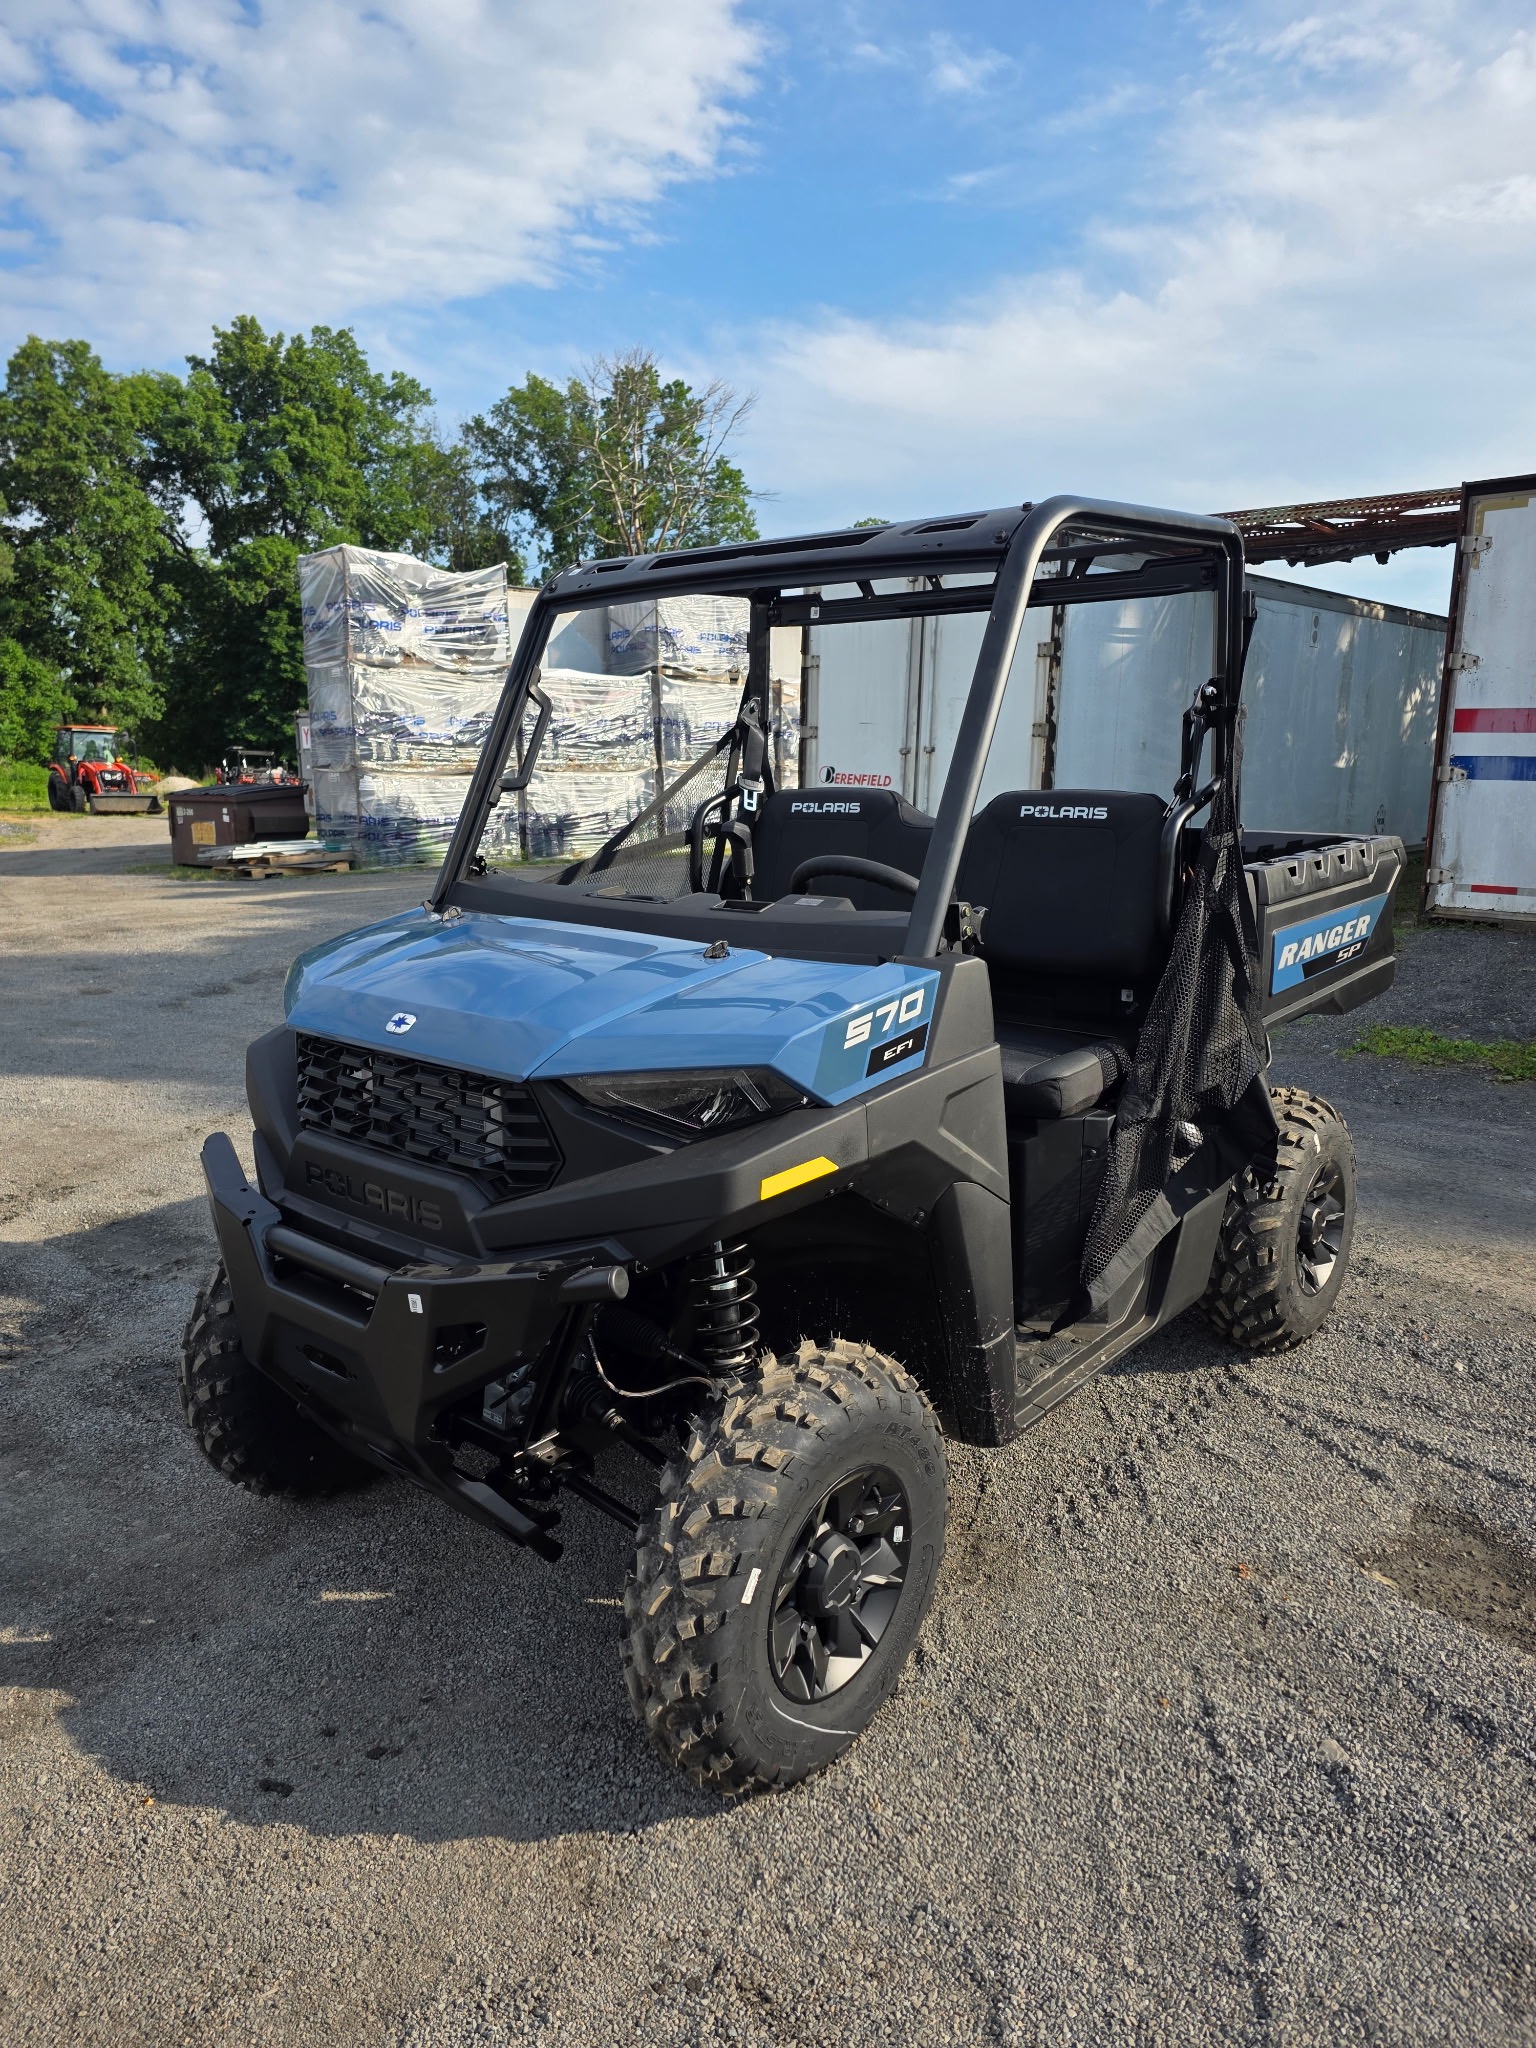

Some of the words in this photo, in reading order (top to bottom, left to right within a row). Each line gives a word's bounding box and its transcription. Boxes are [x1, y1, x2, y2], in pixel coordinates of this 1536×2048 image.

[819, 765, 892, 787] BERENFIELD
[791, 802, 861, 814] POLARIS
[1020, 805, 1108, 820] POLARIS
[1278, 914, 1371, 970] RANGER
[1335, 942, 1363, 963] SP
[843, 988, 925, 1050] 570
[883, 1038, 914, 1061] EFI
[305, 1160, 443, 1231] POLARIS
